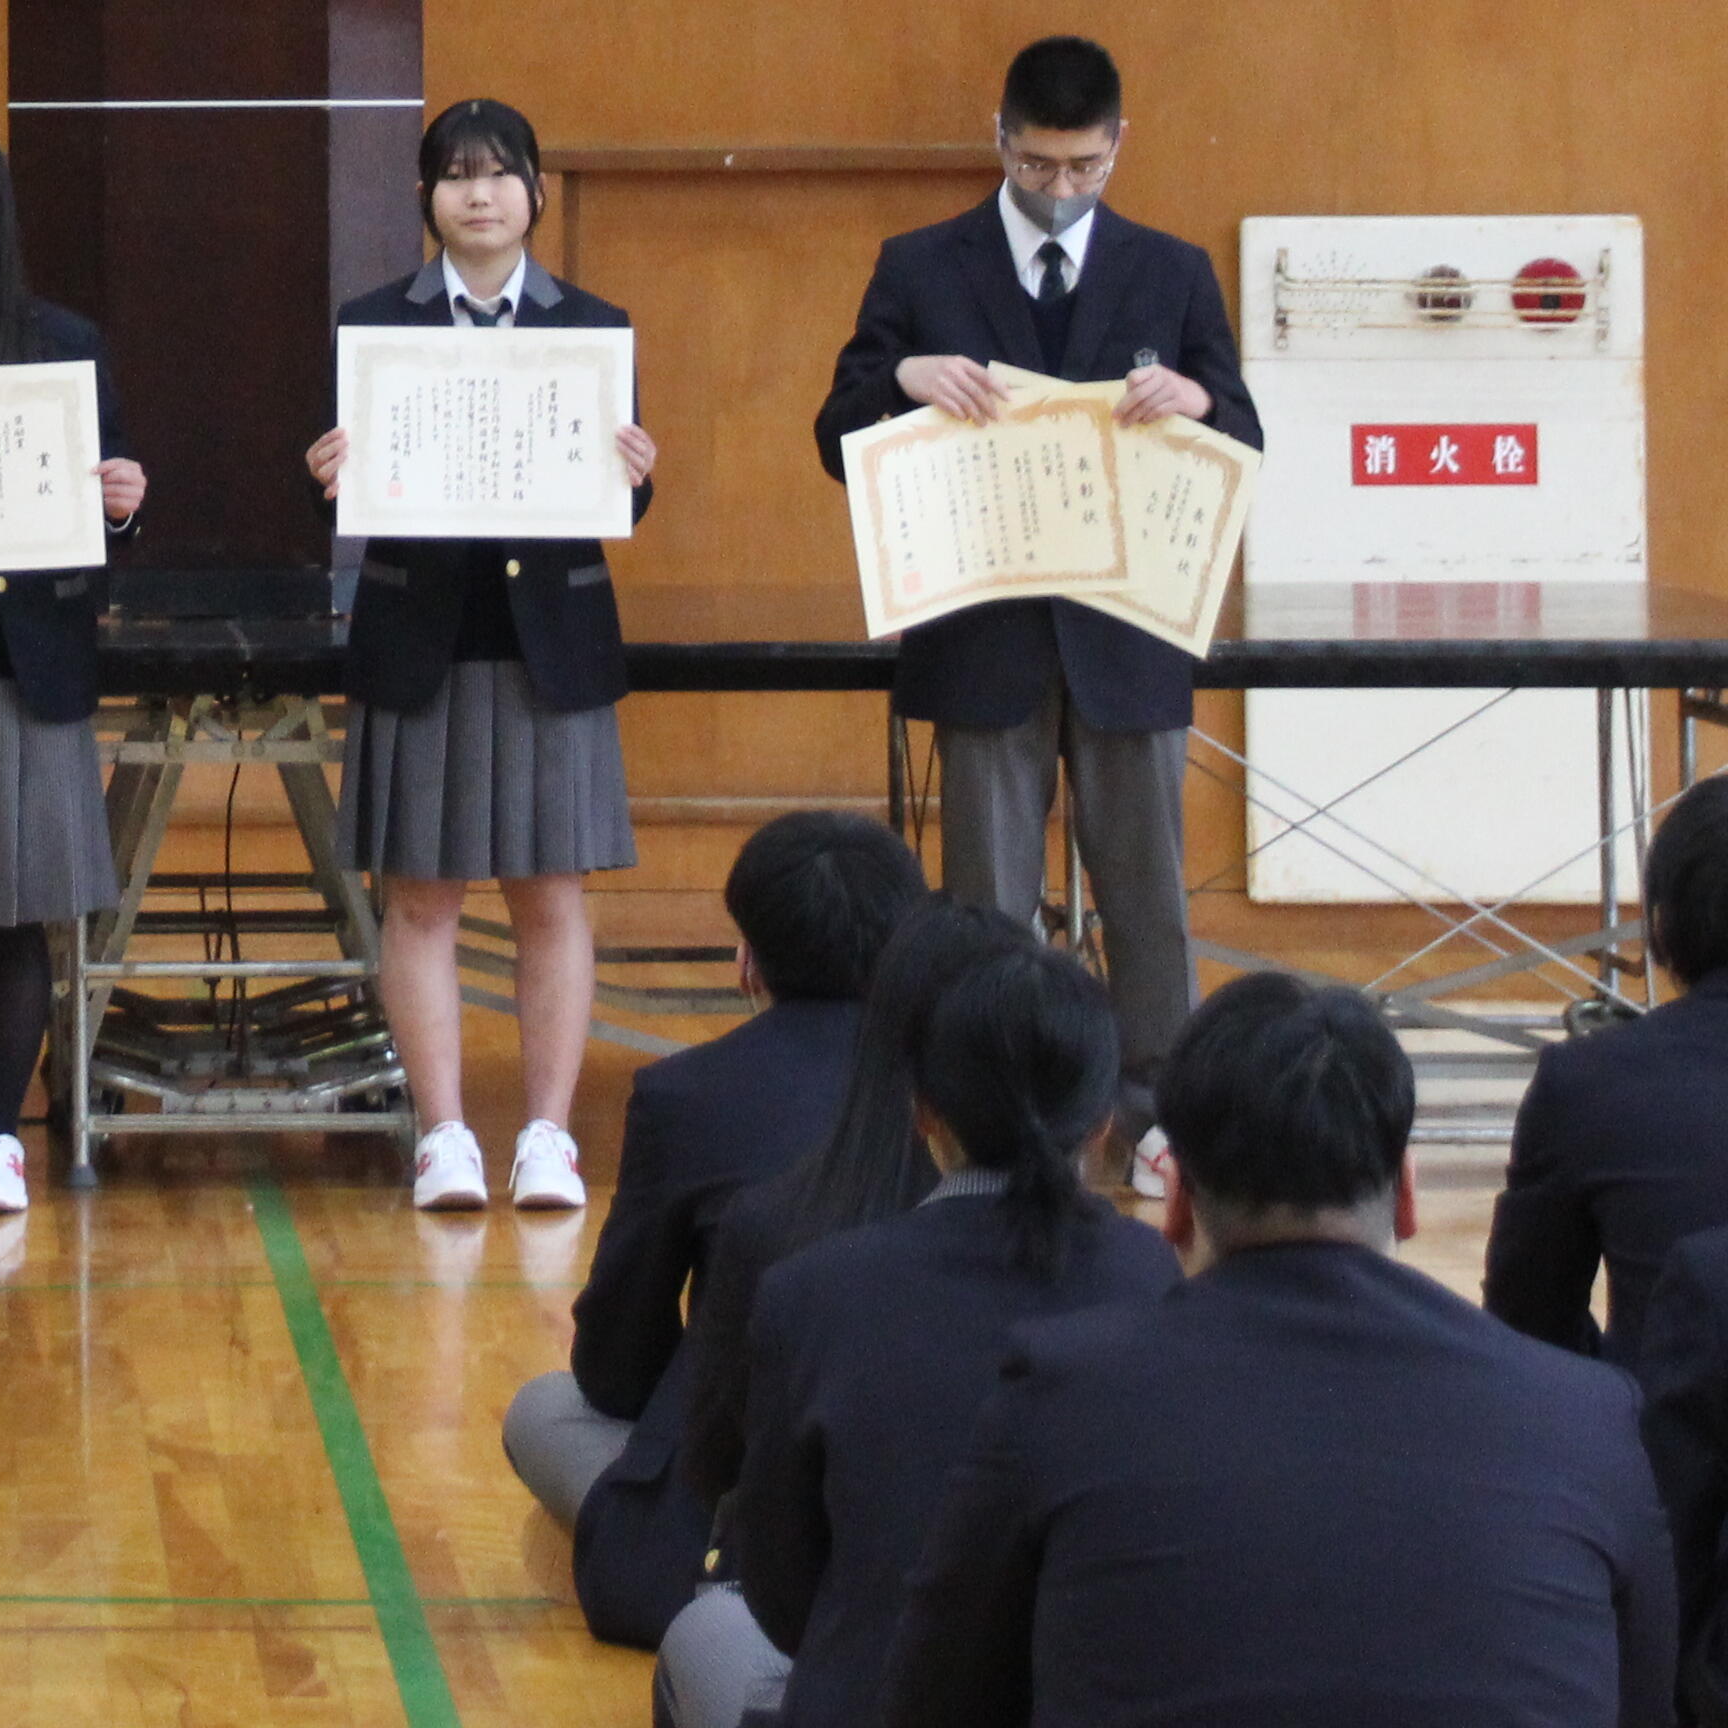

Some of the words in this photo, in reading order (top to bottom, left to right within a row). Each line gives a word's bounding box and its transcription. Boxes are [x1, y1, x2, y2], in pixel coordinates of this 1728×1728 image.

[566, 417, 584, 463] 賞状
[1365, 434, 1525, 475] 消火栓
[36, 452, 53, 496] 賞状
[1077, 456, 1100, 526] 表彰状
[1176, 507, 1206, 577] 表彰状
